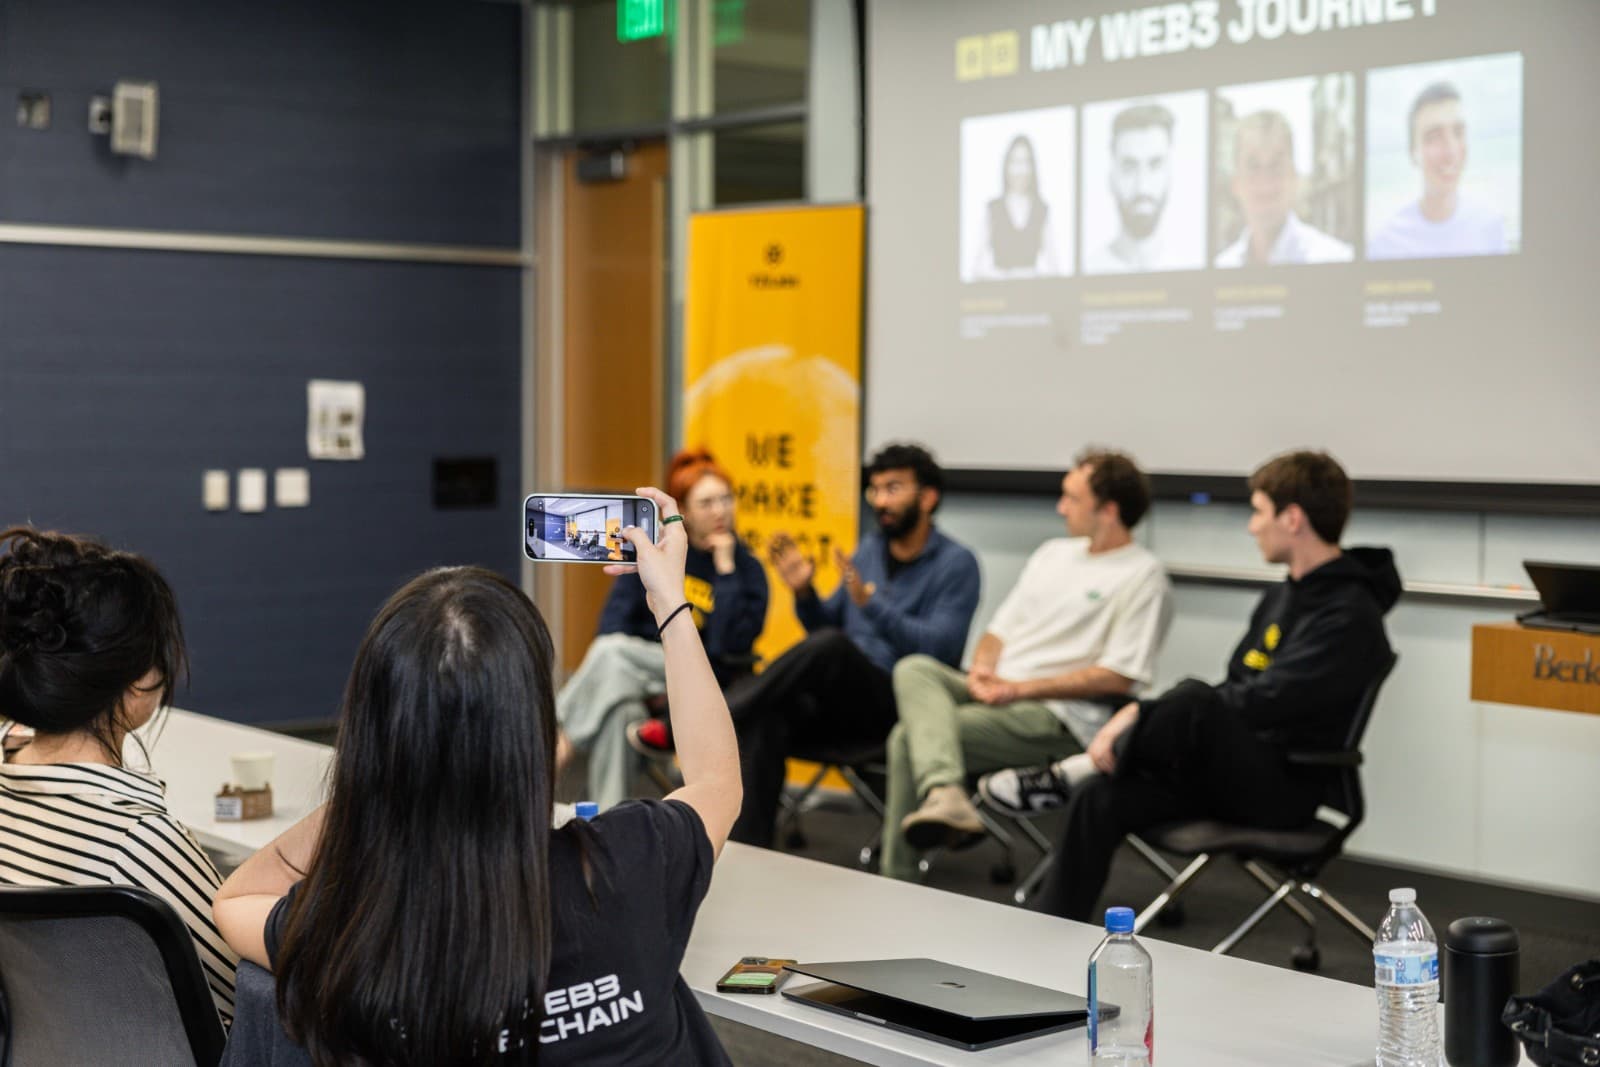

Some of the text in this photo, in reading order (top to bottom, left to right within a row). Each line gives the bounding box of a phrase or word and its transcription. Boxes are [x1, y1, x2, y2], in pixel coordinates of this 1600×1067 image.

[1030, 0, 1437, 72] MY WEB3 JOURN
[745, 432, 795, 468] WE
[534, 973, 621, 1016] EB3
[538, 990, 644, 1044] CHAIN
